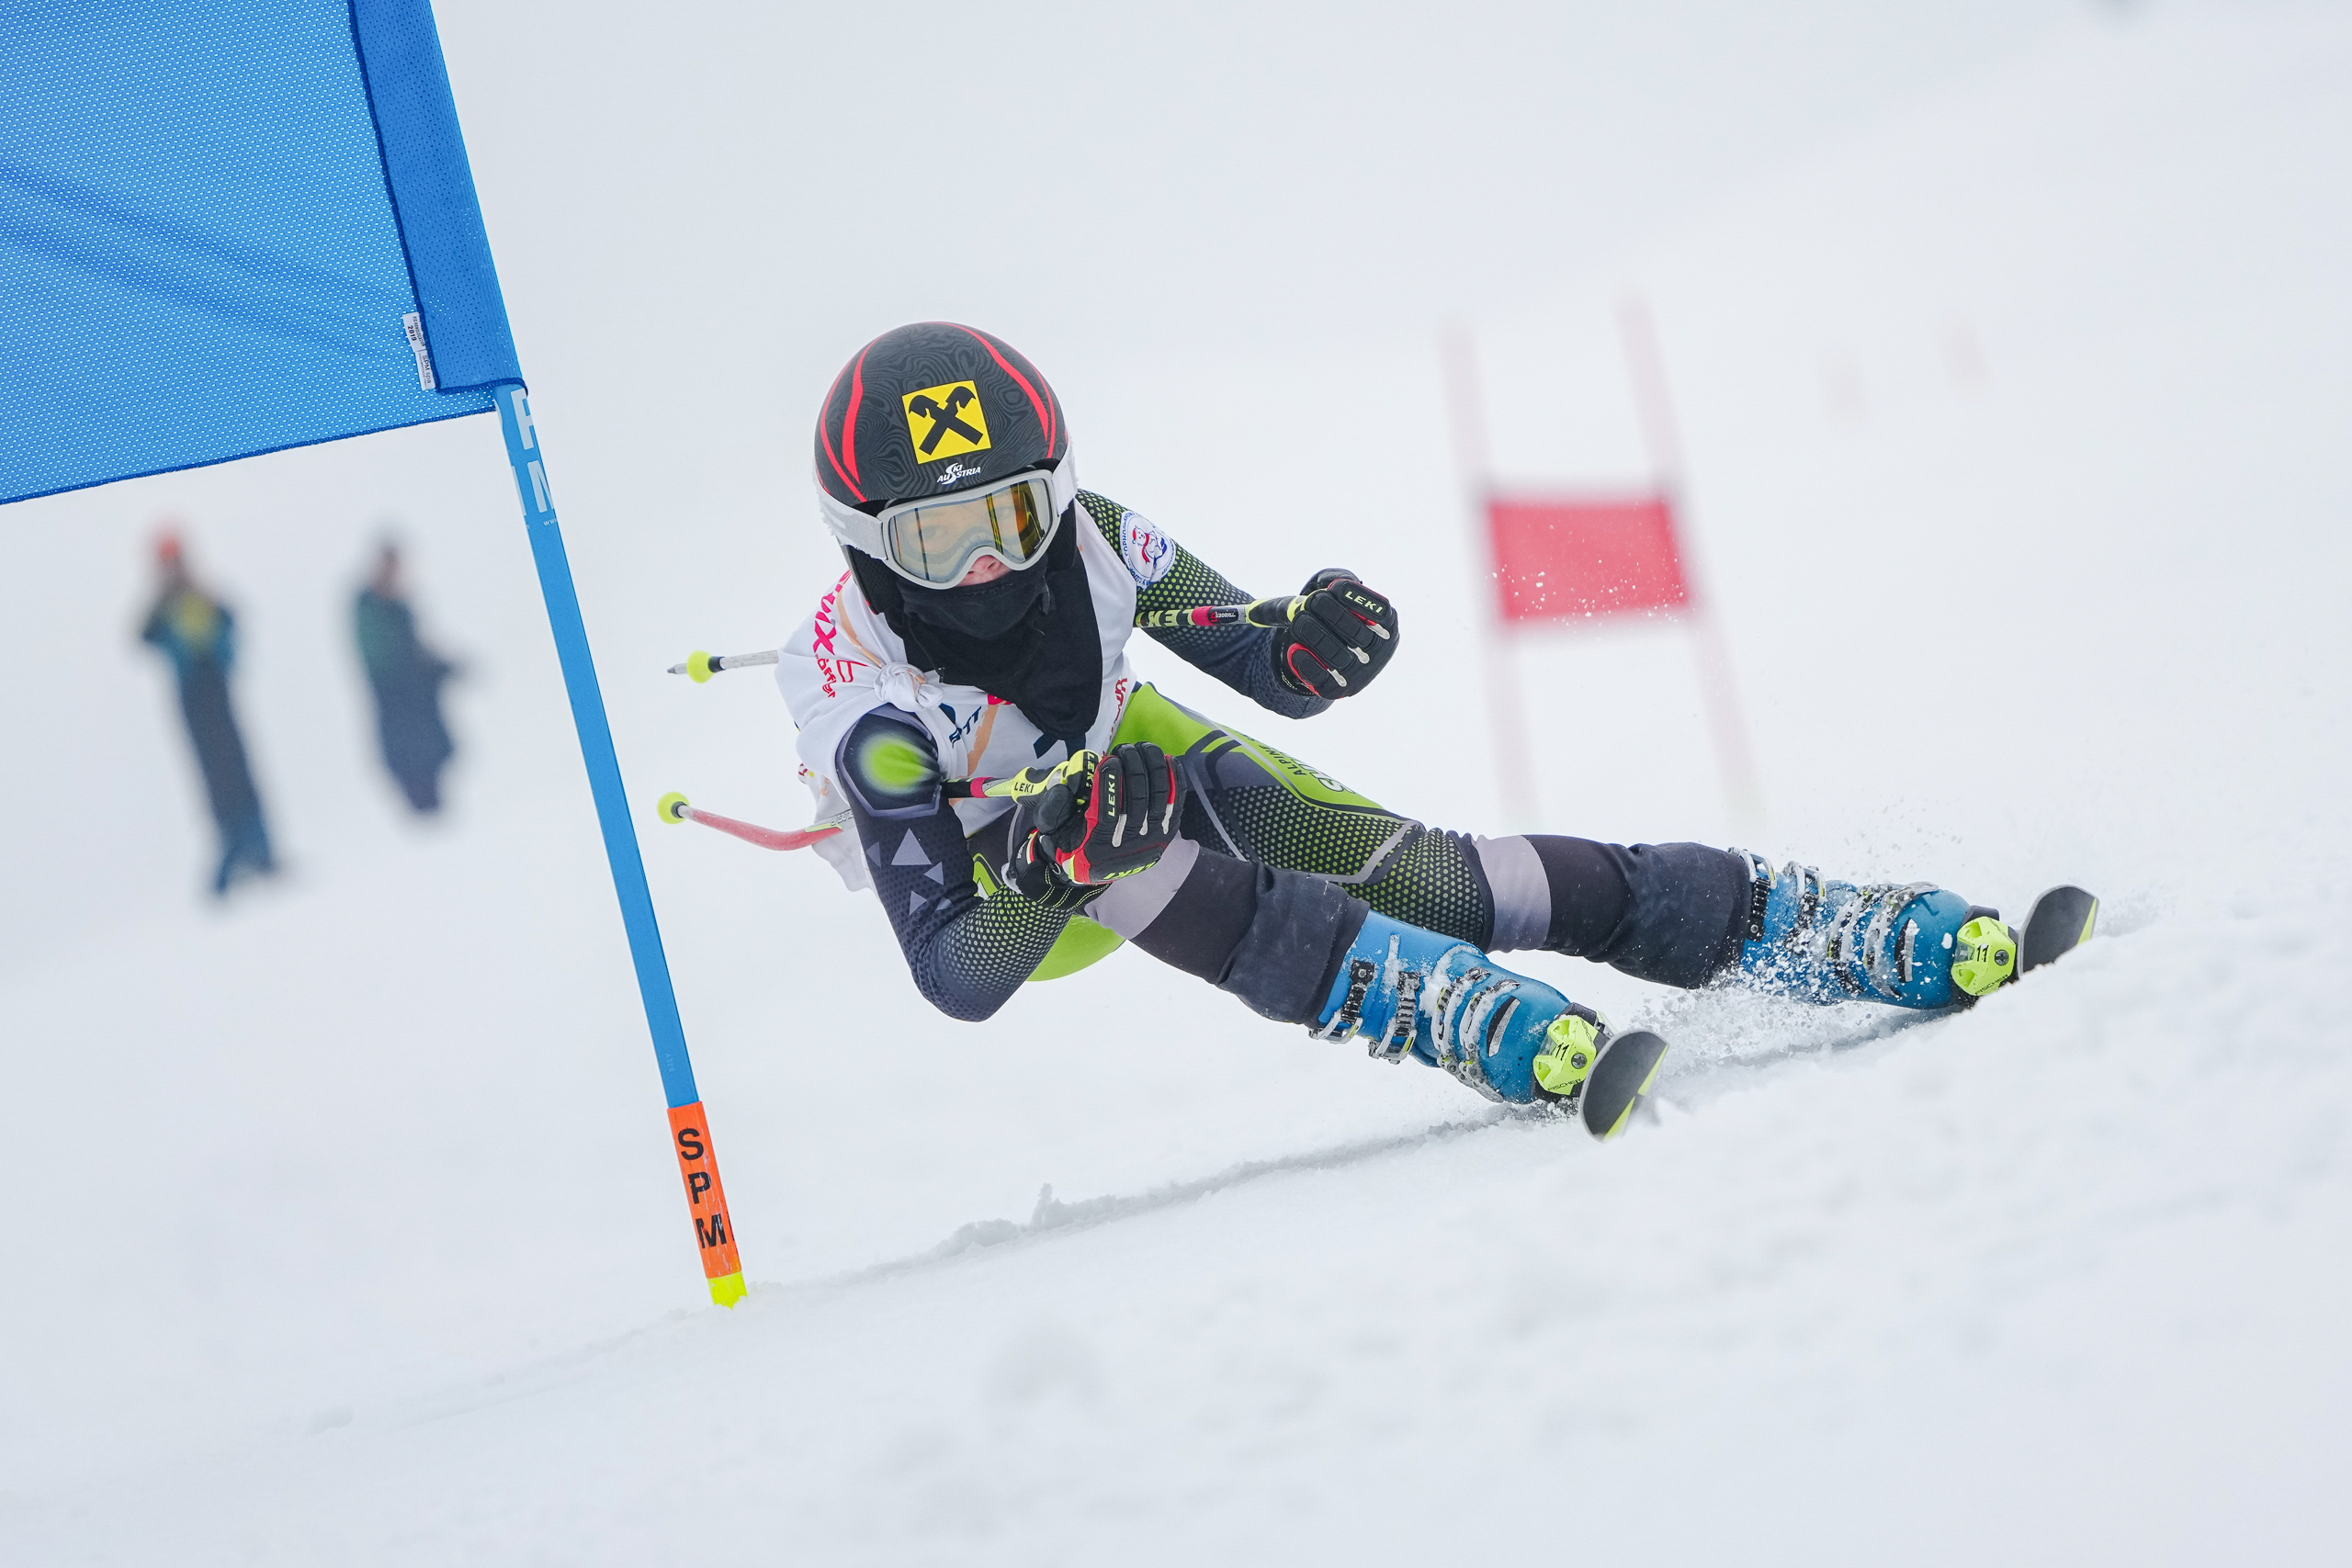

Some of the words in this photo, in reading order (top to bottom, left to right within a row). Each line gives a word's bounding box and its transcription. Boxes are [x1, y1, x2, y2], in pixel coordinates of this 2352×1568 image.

[407, 325, 417, 342] 2019
[1345, 591, 1383, 614] LEKI
[1259, 744, 1306, 776] ALPINE
[1014, 782, 1035, 794] LEKI
[1975, 944, 1989, 963] 11
[1555, 1043, 1569, 1061] 11
[1547, 1078, 1581, 1091] FISCHER
[678, 1128, 727, 1249] SPM
